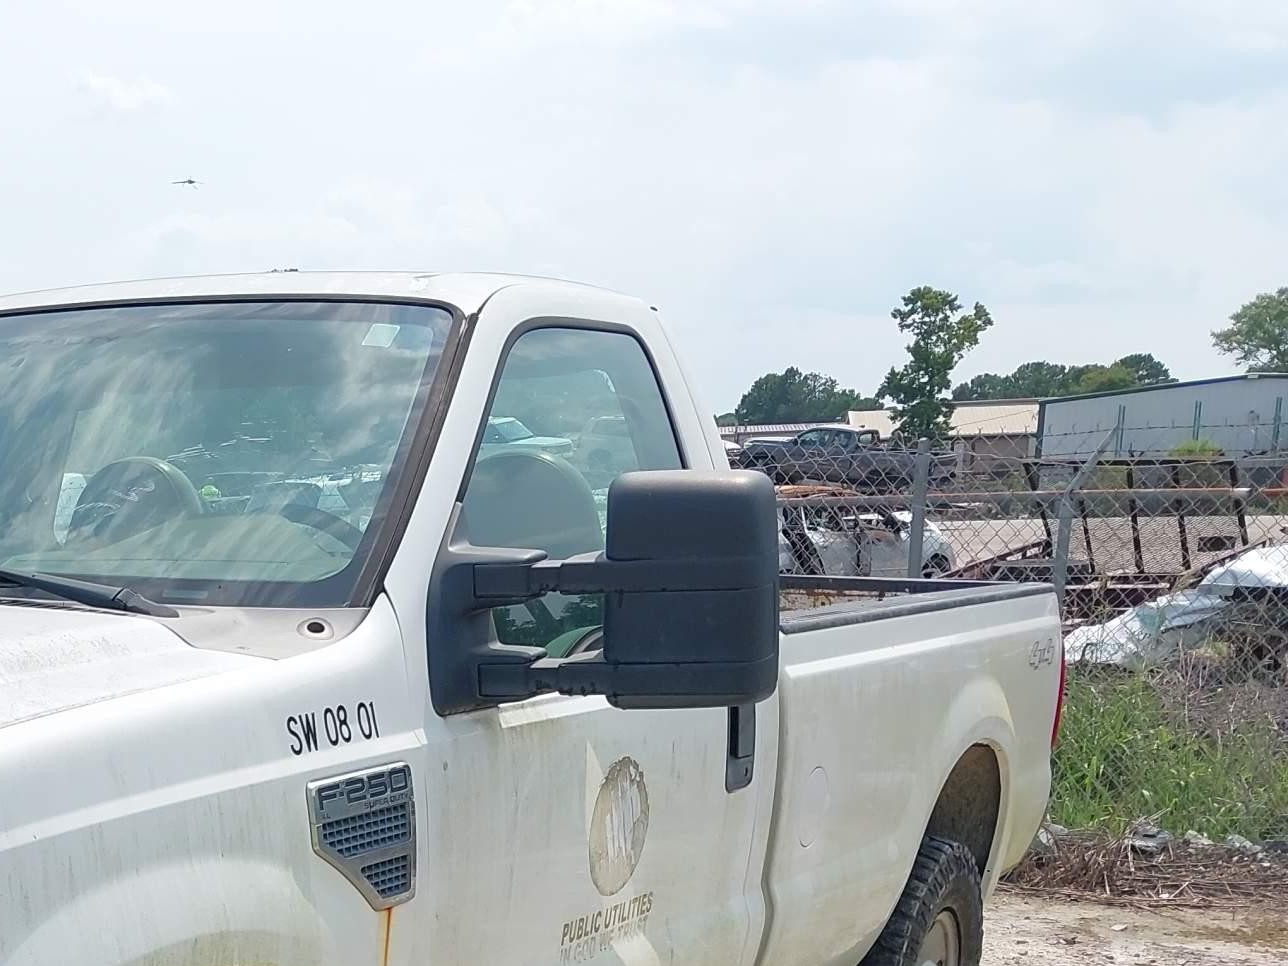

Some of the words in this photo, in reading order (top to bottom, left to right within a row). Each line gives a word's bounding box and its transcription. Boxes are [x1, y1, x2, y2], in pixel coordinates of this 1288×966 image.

[287, 712, 318, 755] SW
[324, 705, 352, 746] 08
[357, 701, 379, 740] 01
[317, 766, 409, 811] F-250
[560, 910, 602, 946] PUBLIC
[604, 891, 654, 929] UTILITIES
